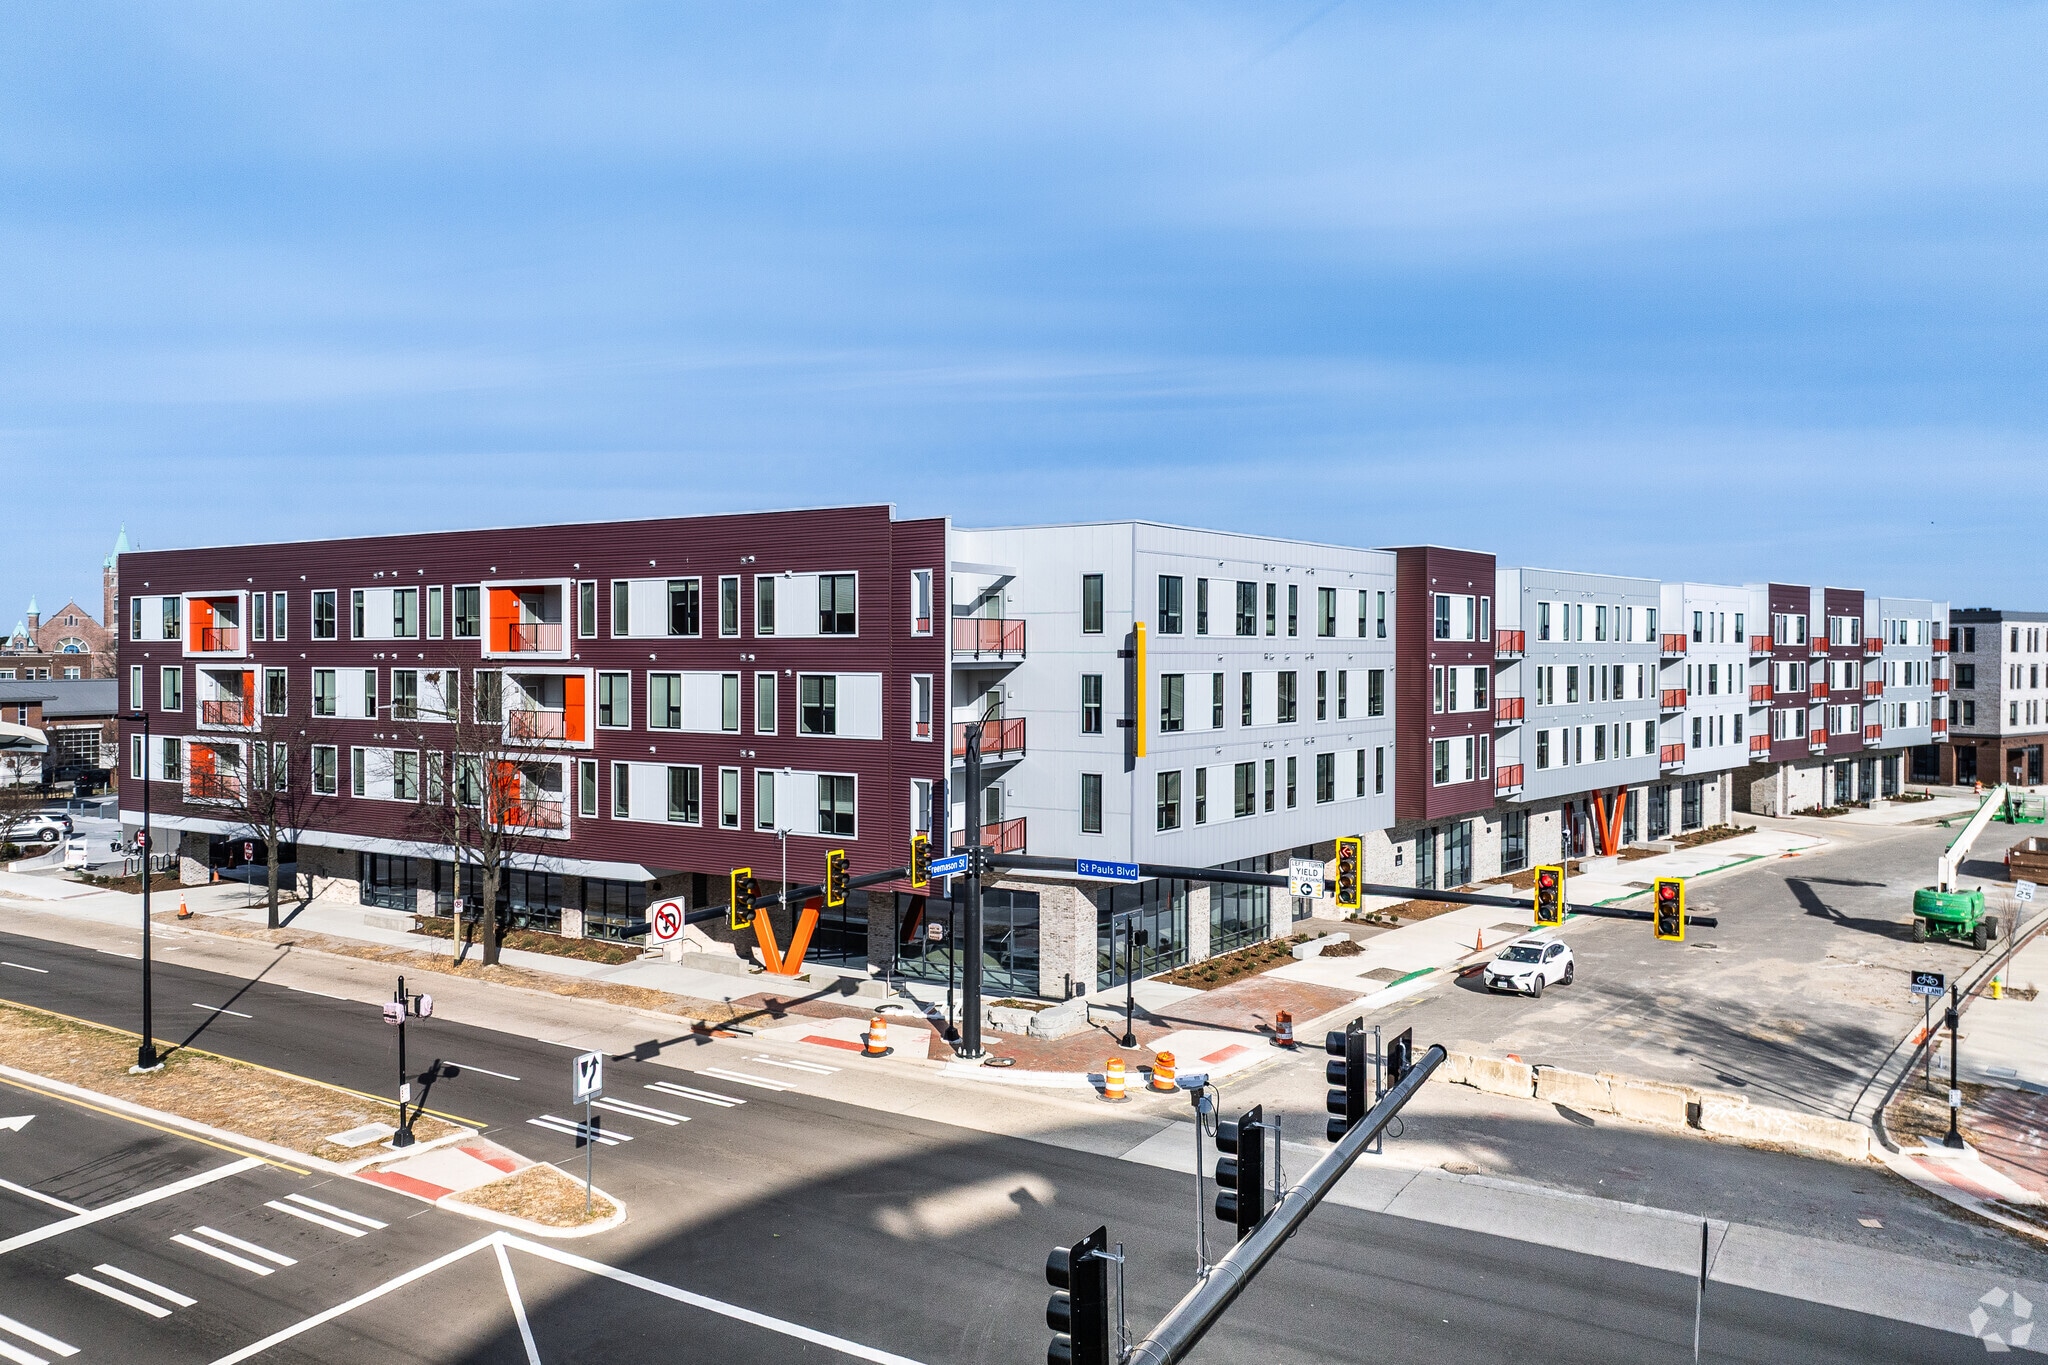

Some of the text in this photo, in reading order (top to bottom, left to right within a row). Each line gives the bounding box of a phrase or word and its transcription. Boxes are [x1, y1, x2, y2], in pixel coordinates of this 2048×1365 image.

[928, 858, 965, 874] Freemason St
[1080, 862, 1136, 877] St Pauls Blvd
[1296, 867, 1319, 877] YIELD
[1300, 876, 1323, 884] FLASHING
[2016, 890, 2032, 900] 25
[1927, 987, 1942, 995] LANE
